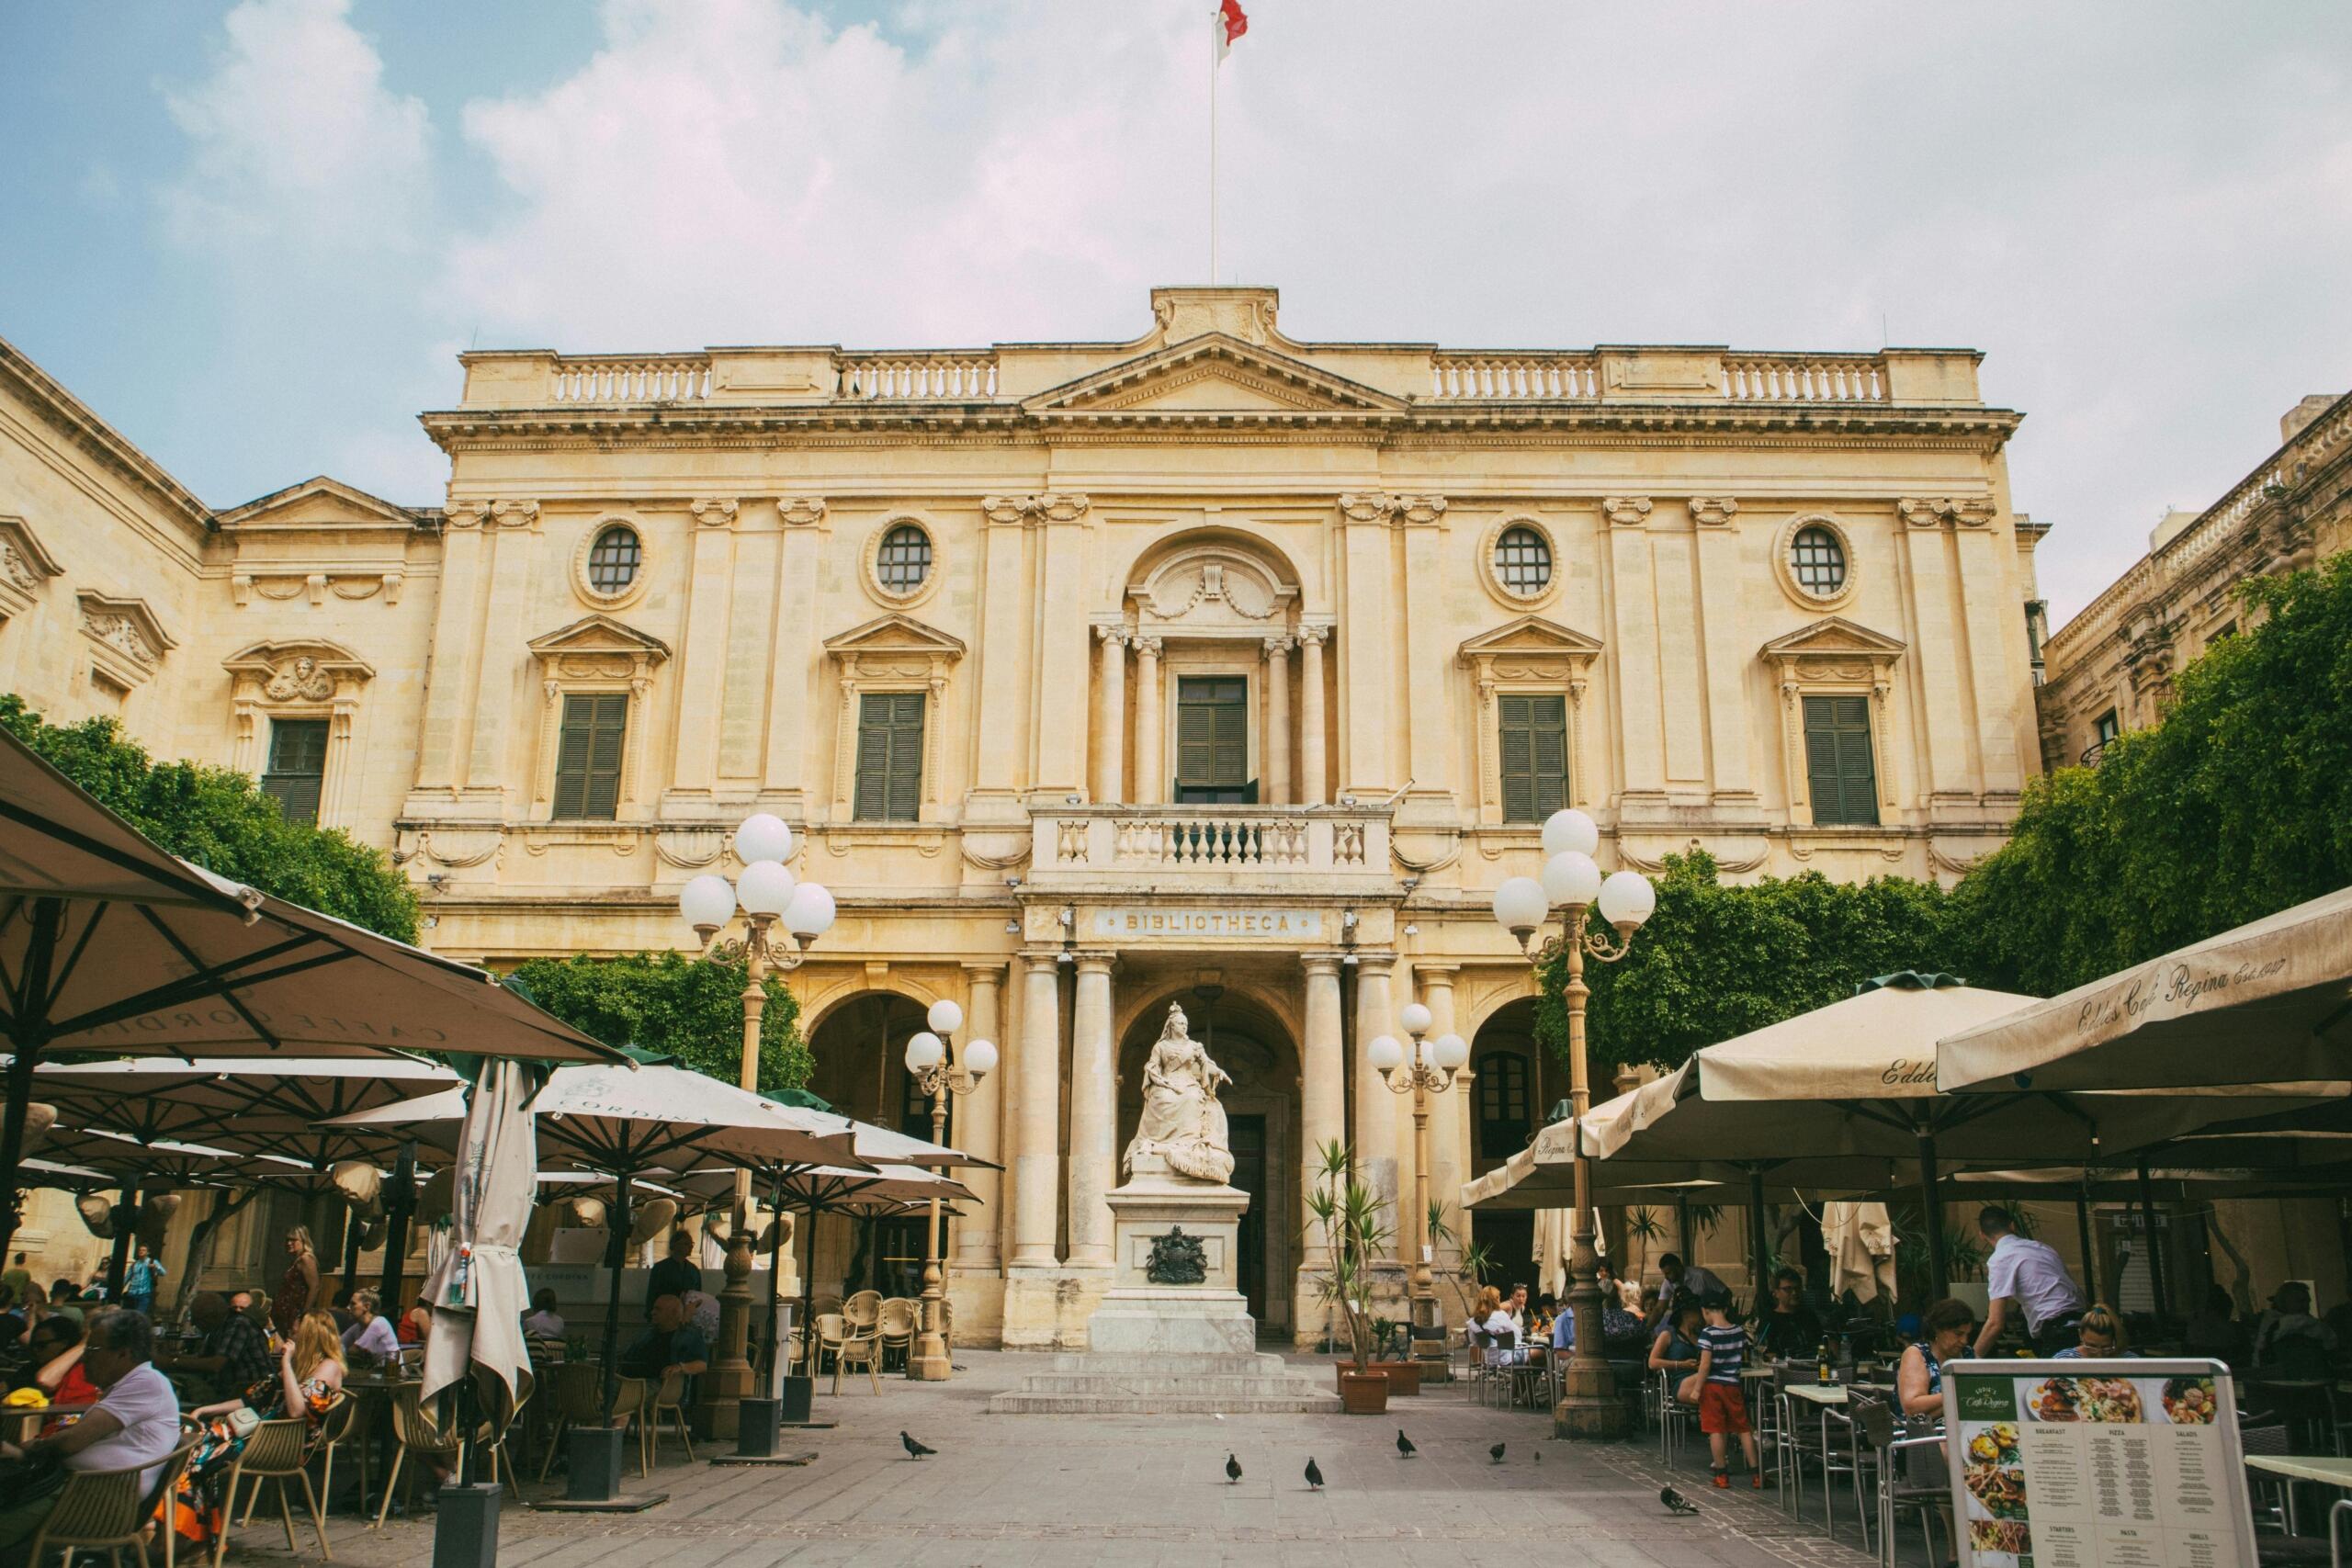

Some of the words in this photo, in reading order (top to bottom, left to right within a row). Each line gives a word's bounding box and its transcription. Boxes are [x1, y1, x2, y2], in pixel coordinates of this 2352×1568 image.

[1126, 914, 1289, 931] BIBLIOTHECA
[2165, 964, 2230, 1010] Regina
[1881, 1058, 1937, 1085] Eddi
